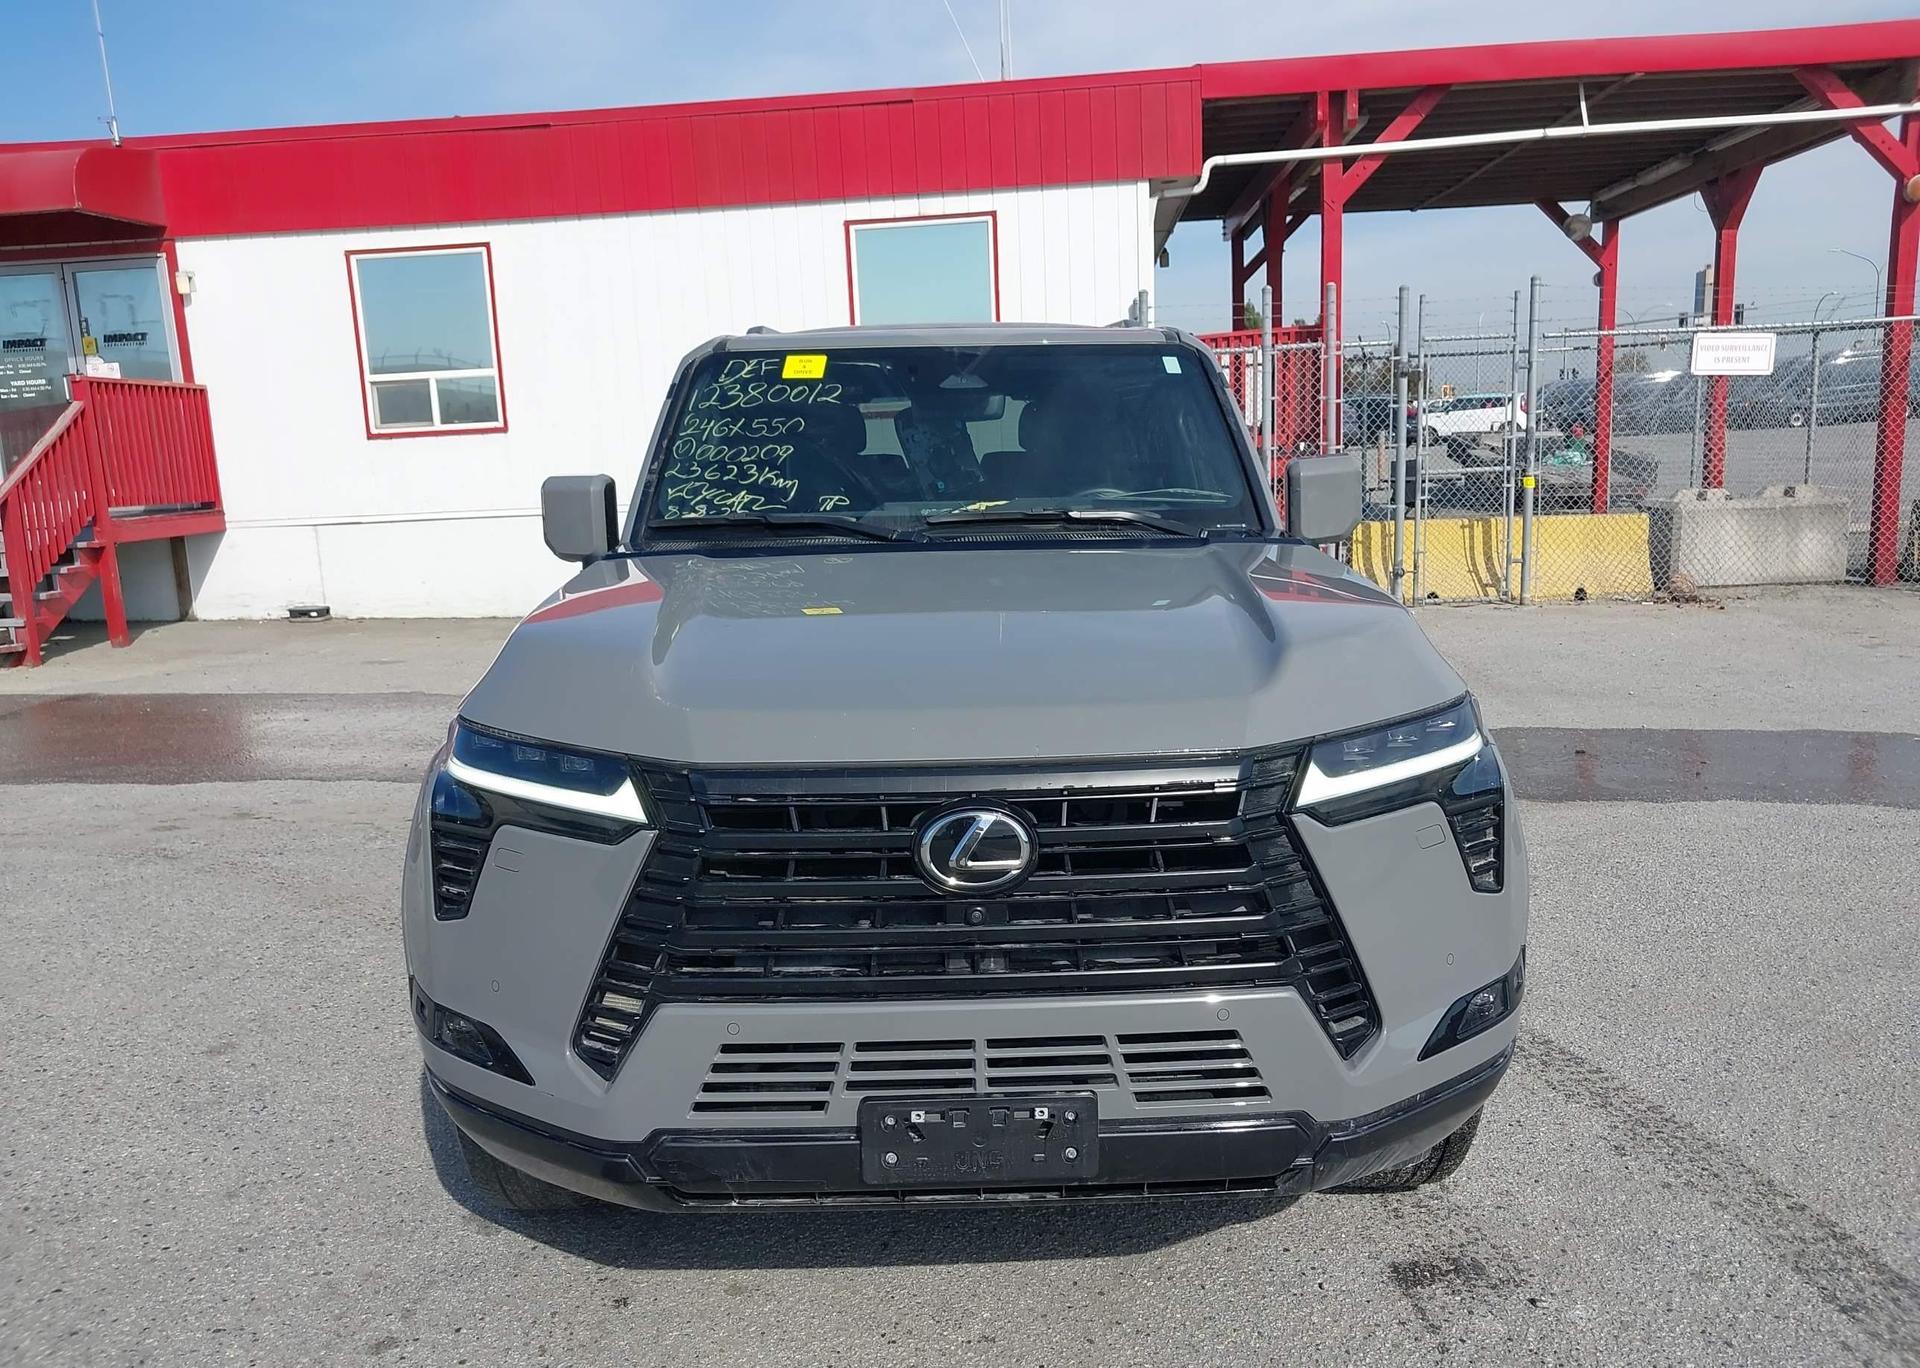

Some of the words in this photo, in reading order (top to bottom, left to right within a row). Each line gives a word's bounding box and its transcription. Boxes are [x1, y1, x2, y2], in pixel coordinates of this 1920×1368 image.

[103, 332, 148, 343] IMPACT
[3, 338, 47, 348] IMPACT
[1700, 344, 1720, 352] VIDEO
[1721, 344, 1768, 352] SURVEILLANCE
[1714, 356, 1721, 364] IS
[1722, 356, 1750, 364] PRESENT
